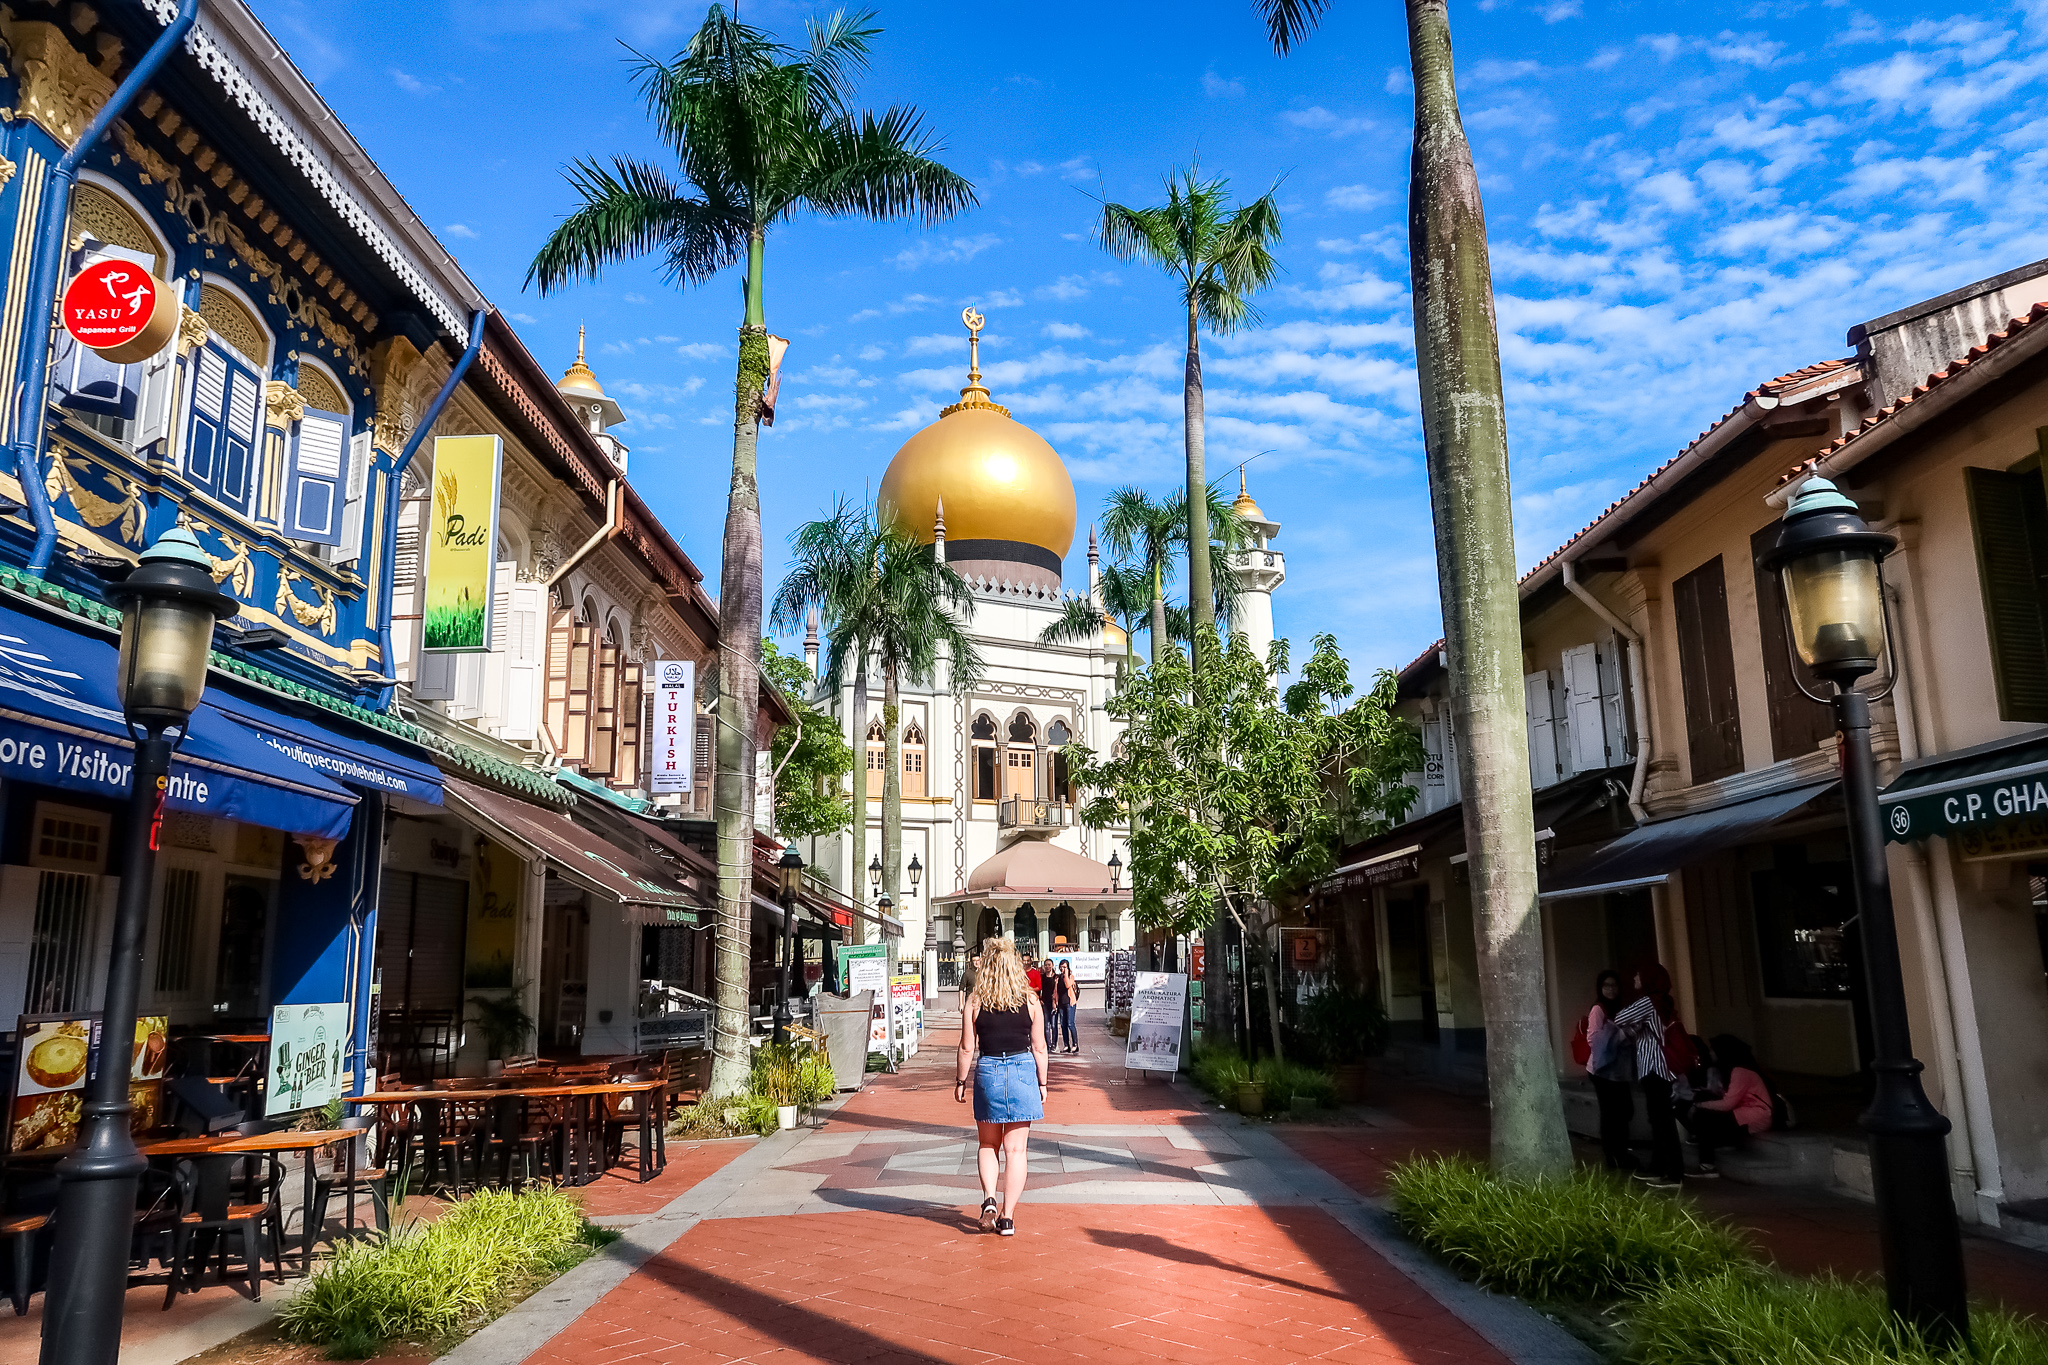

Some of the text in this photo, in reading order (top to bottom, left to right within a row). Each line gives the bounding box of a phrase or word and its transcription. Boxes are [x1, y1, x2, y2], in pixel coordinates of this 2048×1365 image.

[99, 270, 151, 316] やす
[75, 308, 122, 320] YASU
[77, 325, 137, 335] Japanese Grill
[444, 514, 487, 547] Padi
[665, 691, 679, 771] TURKISH
[57, 741, 132, 787] Visitor
[1894, 811, 1907, 829] 36
[1943, 793, 1987, 824] C.P.
[1302, 940, 1309, 951] 2
[295, 1042, 326, 1073] GINGER
[304, 1060, 327, 1086] BEER
